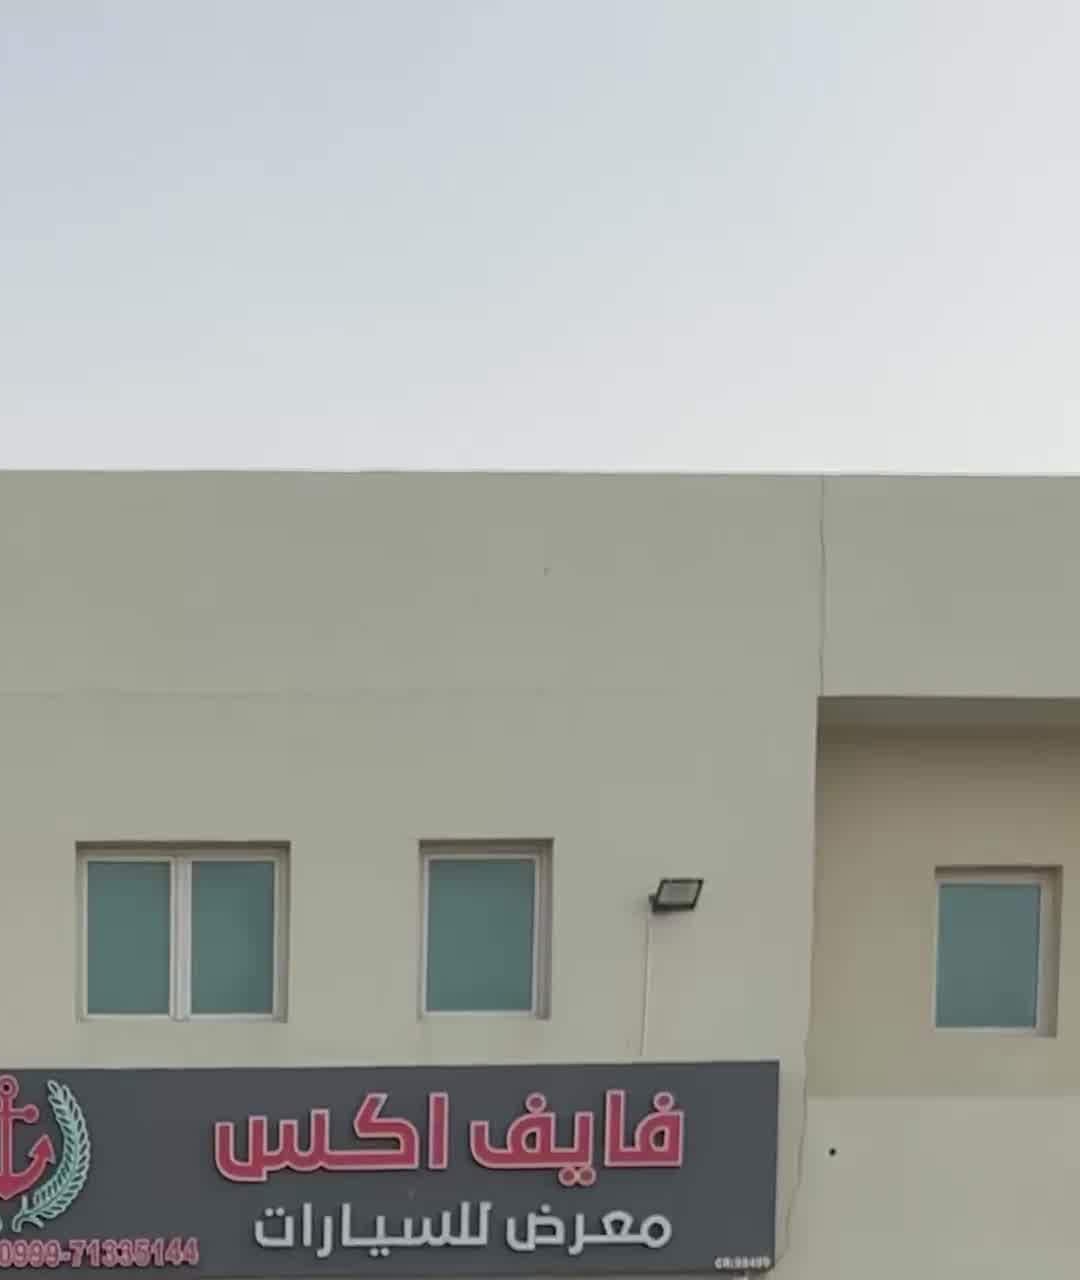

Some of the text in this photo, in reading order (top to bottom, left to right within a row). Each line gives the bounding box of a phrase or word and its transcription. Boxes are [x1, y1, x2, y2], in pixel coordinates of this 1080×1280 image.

[214, 1088, 684, 1187] فايف اكس
[253, 1201, 673, 1257] معرض للسيارات
